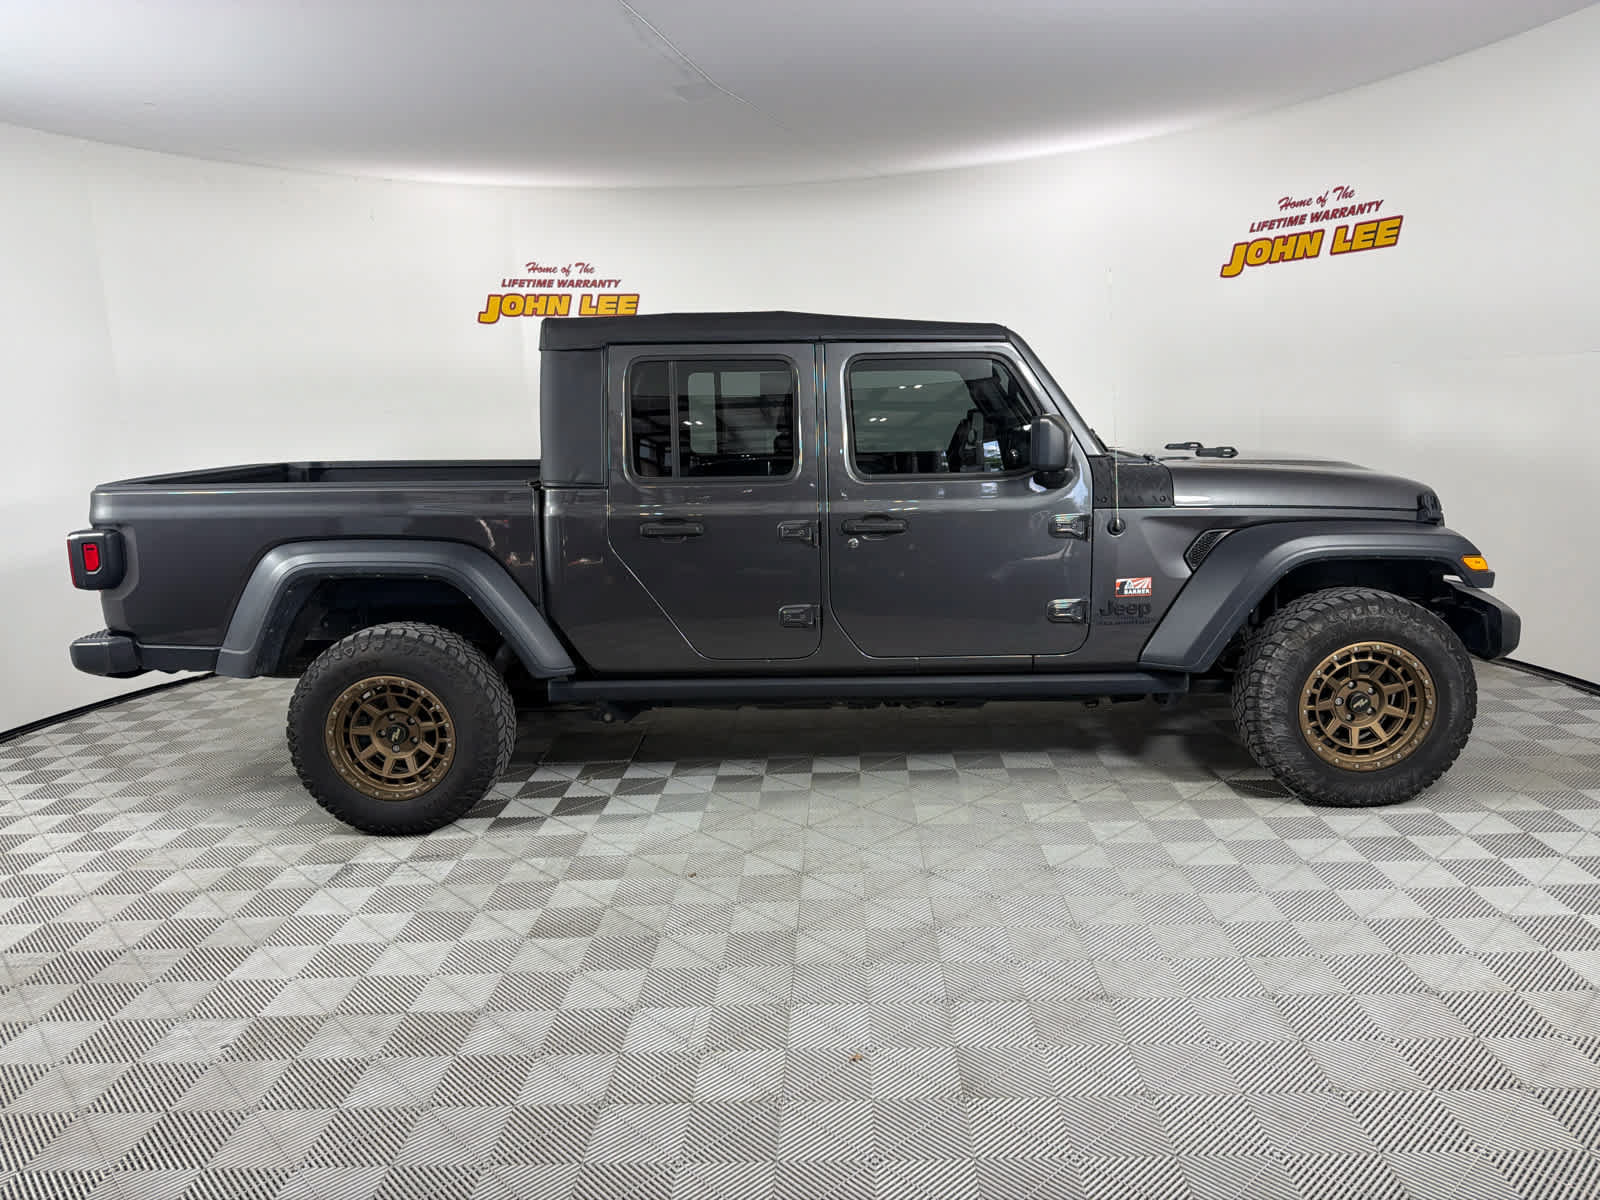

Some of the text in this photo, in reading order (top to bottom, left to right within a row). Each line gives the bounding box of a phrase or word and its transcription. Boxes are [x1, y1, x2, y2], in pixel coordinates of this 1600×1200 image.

[1278, 186, 1355, 211] Home of The
[1249, 200, 1384, 233] LIFETIME WARRANTY
[1220, 215, 1403, 278] JOHN LEE
[525, 262, 595, 276] Home of The
[501, 279, 621, 288] LIFETIME WARRANTY
[478, 293, 640, 325] JOHN LEE
[1099, 600, 1152, 617] Jeep
